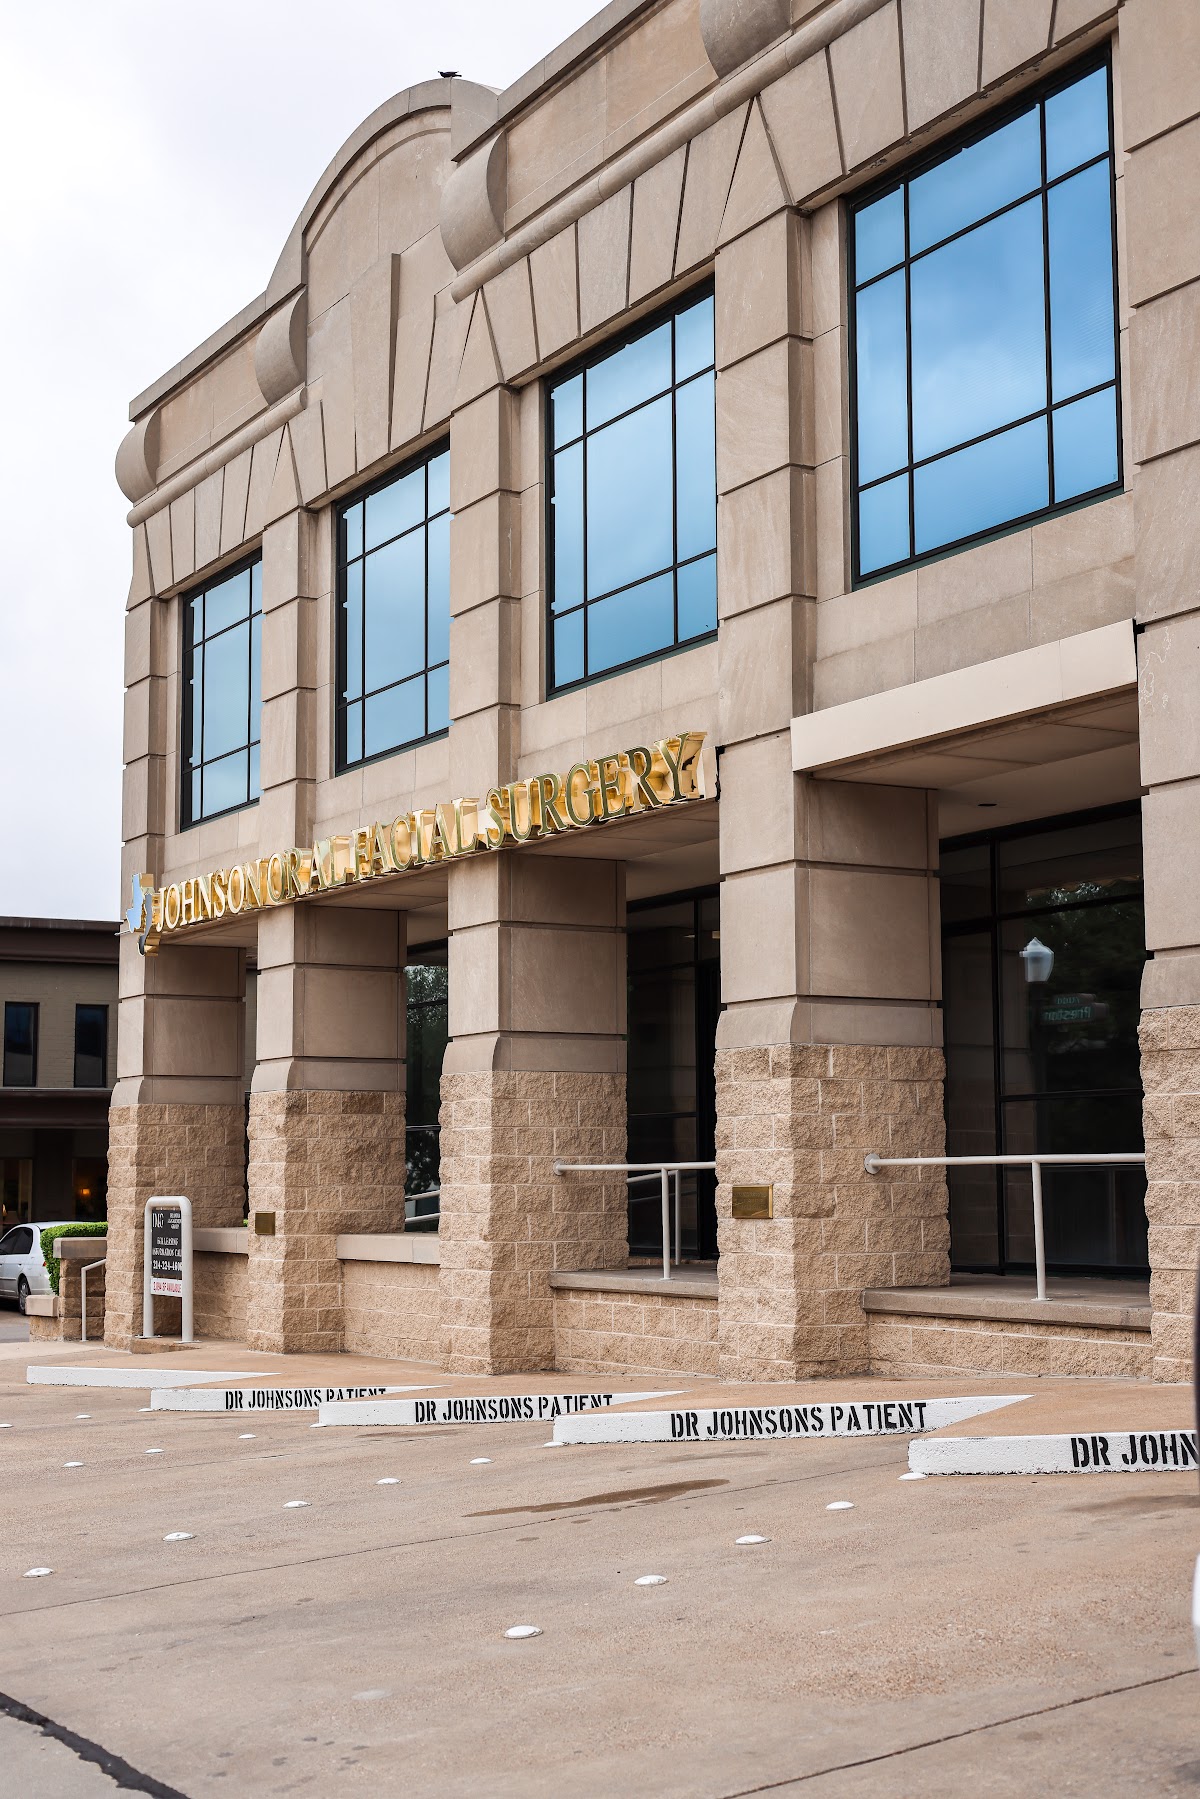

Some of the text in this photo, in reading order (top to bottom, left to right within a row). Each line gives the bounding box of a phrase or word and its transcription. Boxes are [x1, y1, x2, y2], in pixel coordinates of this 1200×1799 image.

[155, 731, 703, 933] JOHNSON ORAL FACIAL SURGERY
[225, 1390, 243, 1410] DR
[248, 1388, 323, 1410] JOHNSONS
[414, 1400, 437, 1423] DR
[442, 1396, 534, 1421] JOHNSONS
[670, 1402, 927, 1438] DR JOHNSONS PATIENT
[1070, 1435, 1111, 1468] DR
